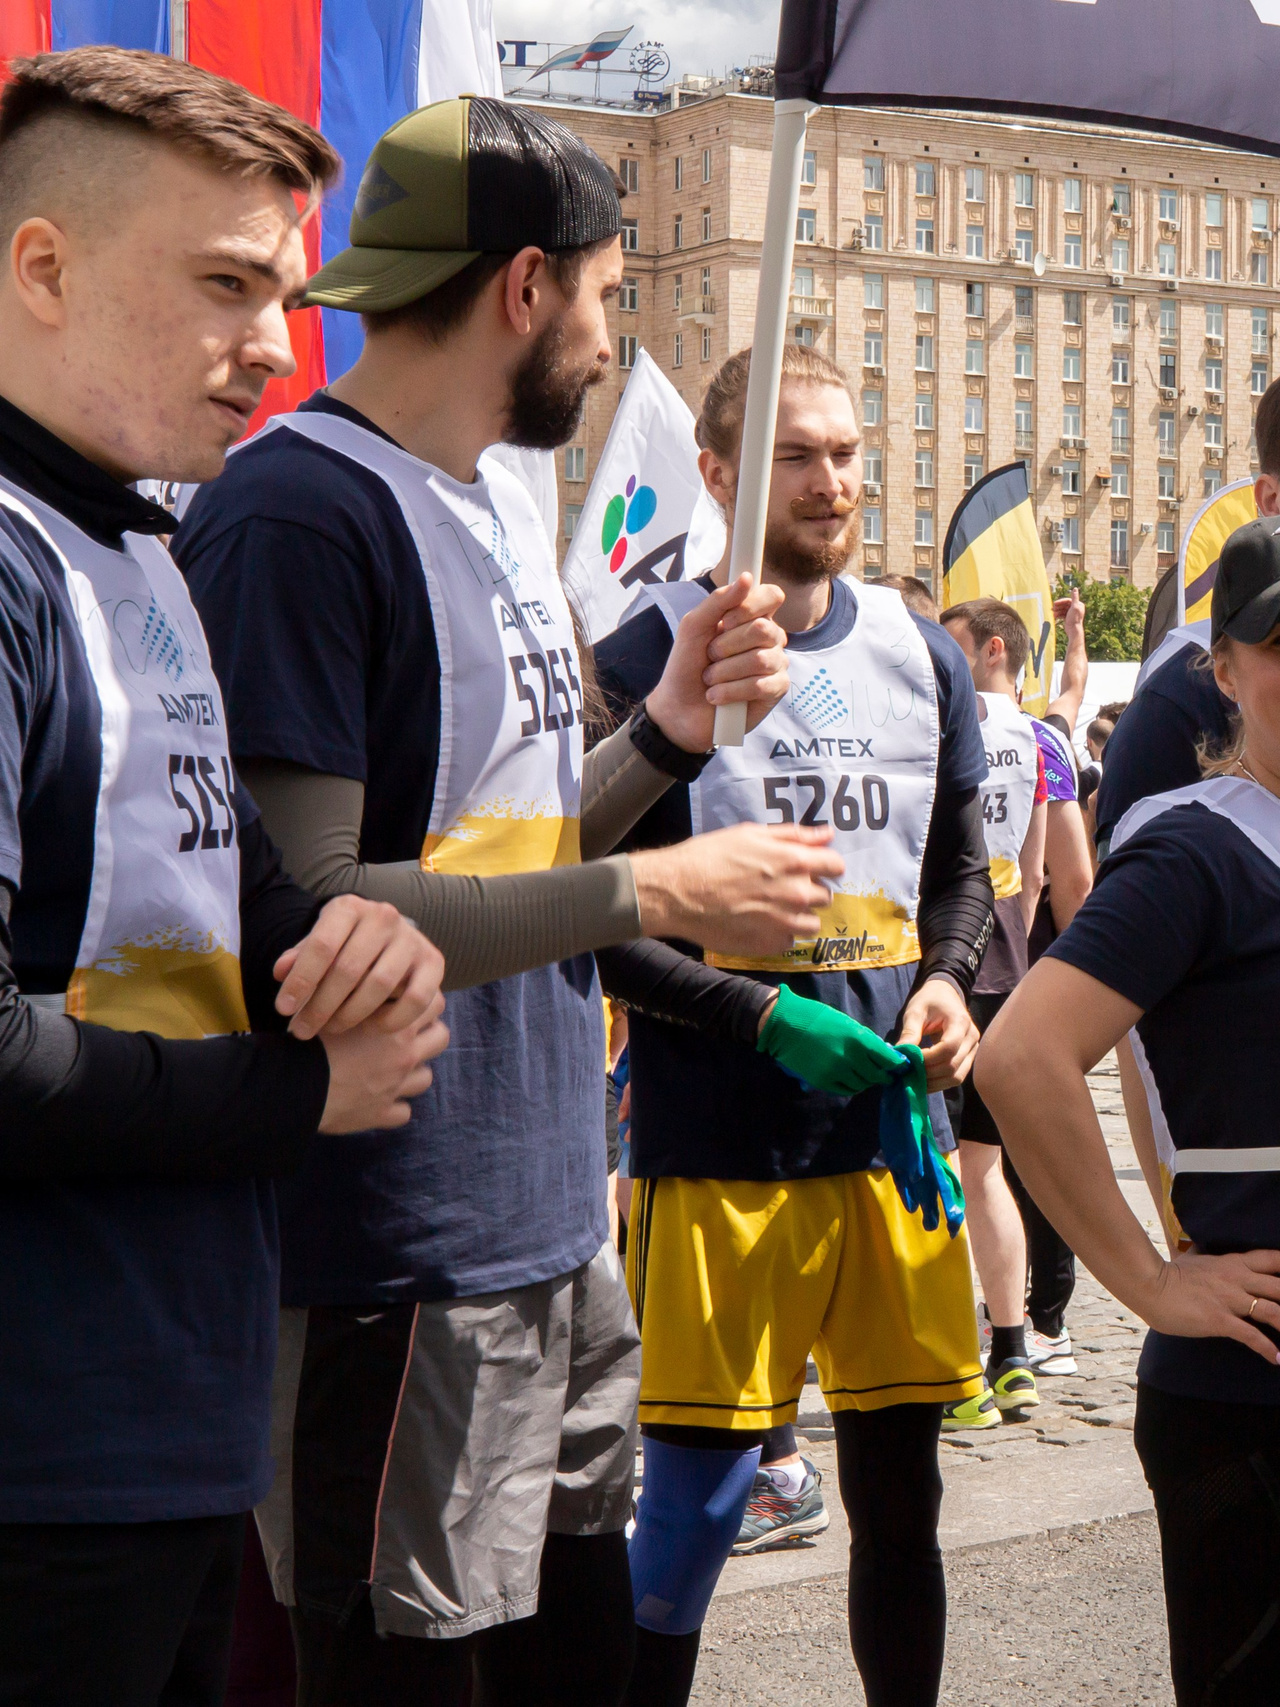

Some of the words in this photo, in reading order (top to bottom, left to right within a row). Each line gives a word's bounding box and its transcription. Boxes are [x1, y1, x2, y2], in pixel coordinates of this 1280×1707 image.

[500, 600, 556, 632] AMTEX
[157, 693, 220, 726] AMTEX
[508, 646, 584, 738] 5255
[769, 737, 875, 760] AMTEX
[763, 773, 891, 832] 5260
[811, 929, 868, 966] URBAN
